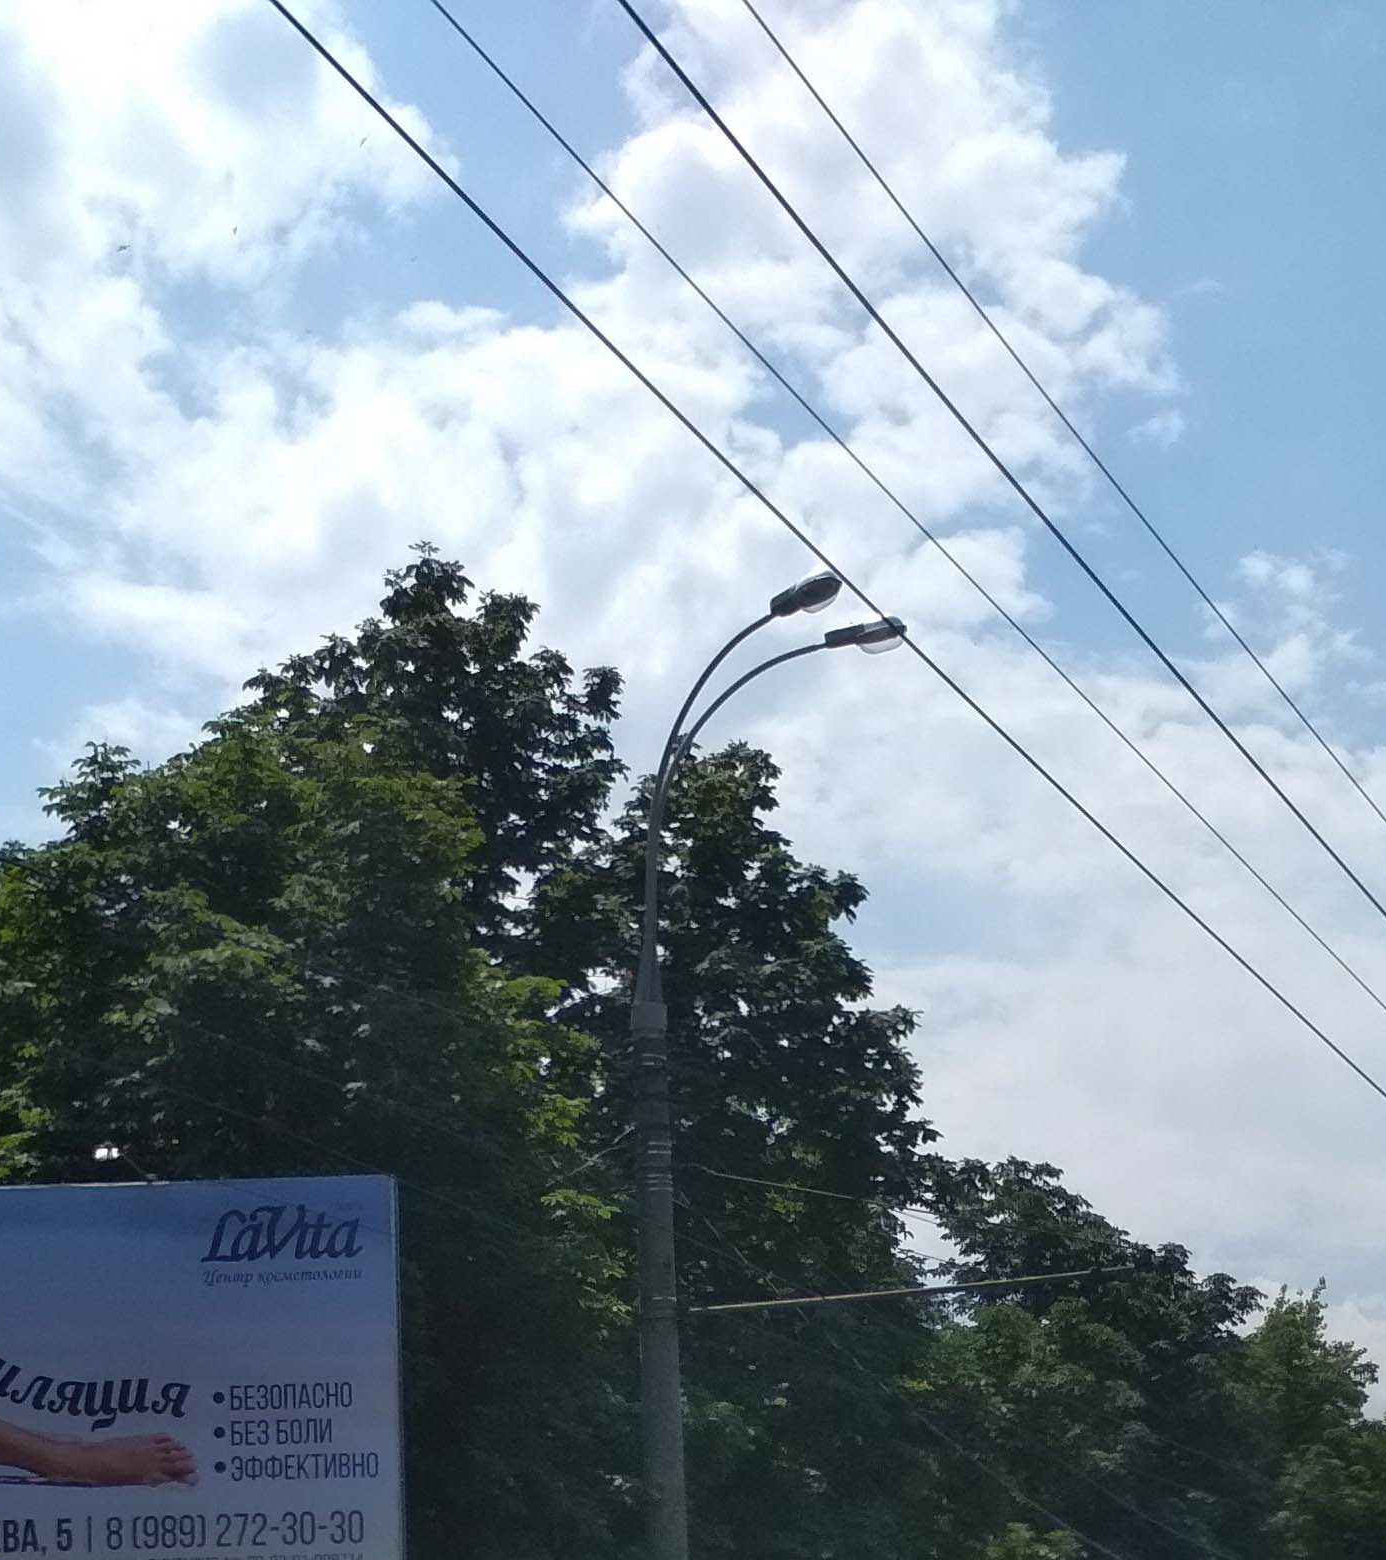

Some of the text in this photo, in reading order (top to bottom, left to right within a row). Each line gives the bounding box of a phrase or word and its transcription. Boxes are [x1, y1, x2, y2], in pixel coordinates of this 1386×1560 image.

[201, 1204, 364, 1262] LaVita
[202, 1268, 254, 1287] Центр
[229, 1381, 353, 1411] БЕЗОПАСНО
[230, 1418, 333, 1446] БЕЗ БОЛИ
[230, 1452, 380, 1482] ЭФФЕКТИВНО
[55, 1518, 73, 1552] 5
[105, 1509, 365, 1549] 8 (989) 272-30-30
